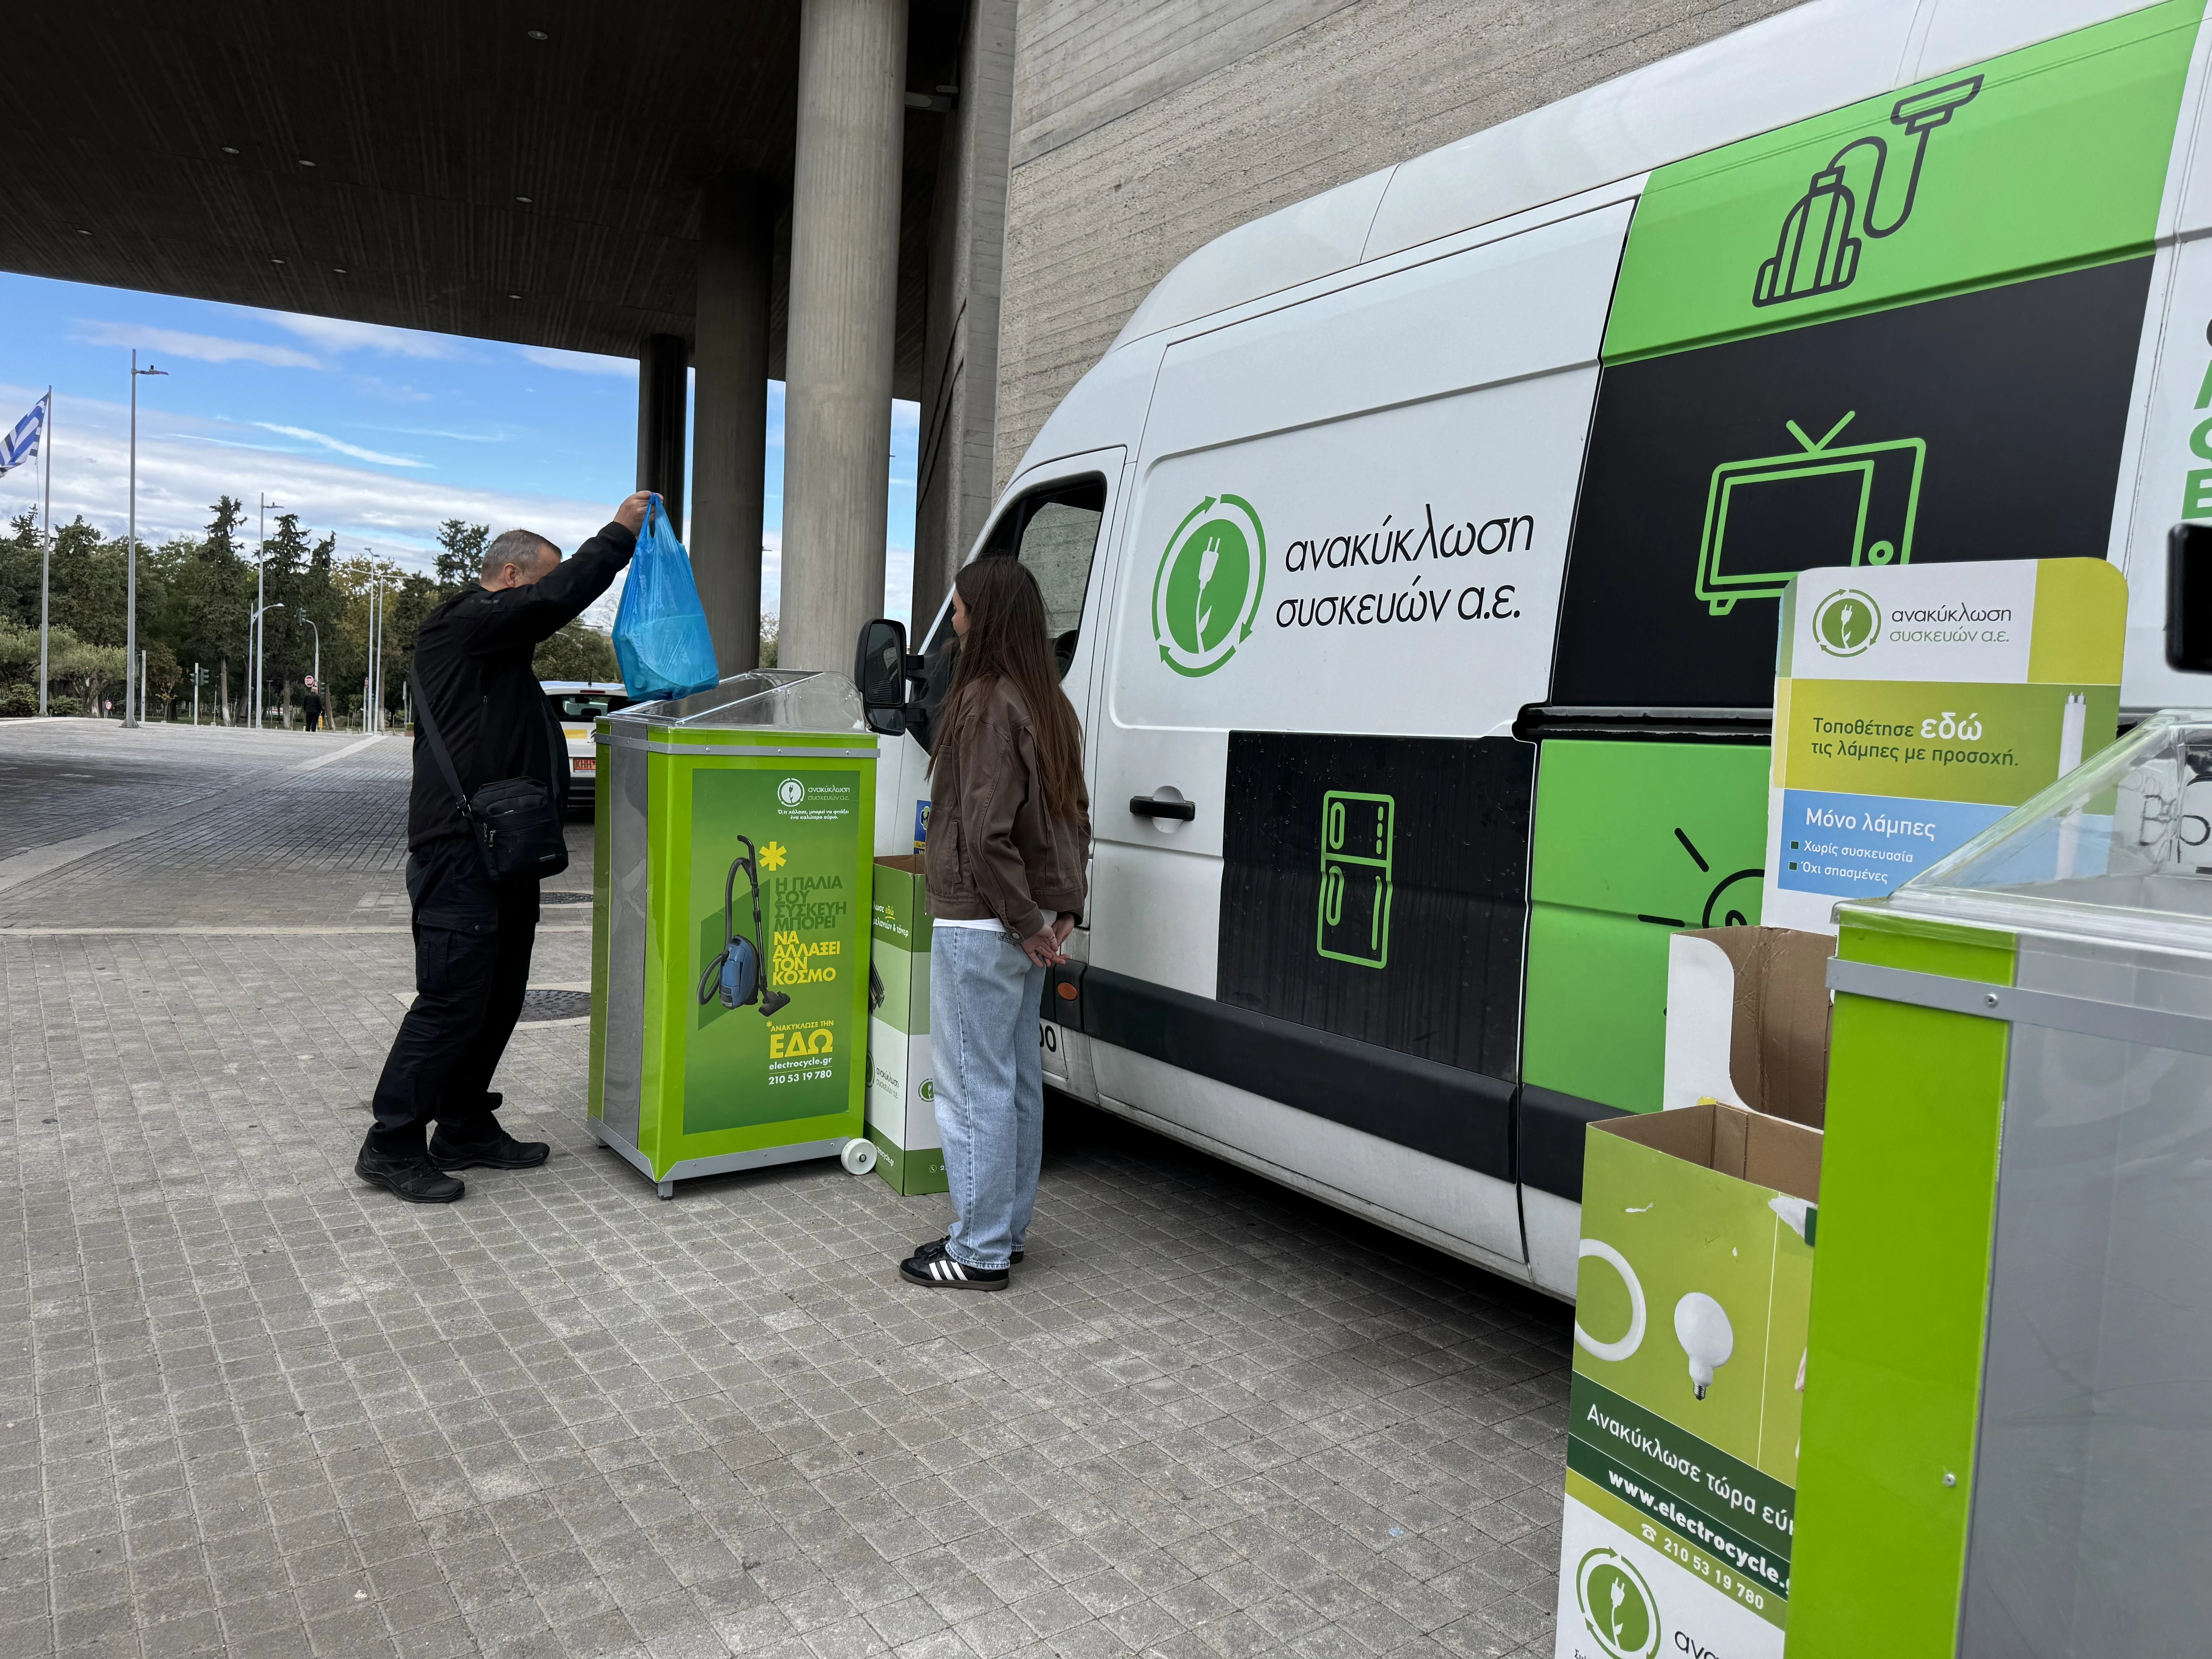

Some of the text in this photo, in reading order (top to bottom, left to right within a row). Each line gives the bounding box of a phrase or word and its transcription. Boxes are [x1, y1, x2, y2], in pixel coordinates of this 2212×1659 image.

[1286, 504, 1534, 572] ανακύκλωση
[1276, 576, 1520, 627] συσκευών α.ε.
[1891, 602, 2011, 623] ανακύκλωση
[1890, 626, 2009, 643] συσκευών α.ε.
[1813, 712, 1982, 741] Τοποθέτησε εδώ
[1812, 740, 2018, 767] τις λάμπες με προσοχή.
[808, 785, 850, 793] ανακύκλωση
[1806, 807, 1936, 841] Μόνο λάμπες
[1804, 840, 1913, 863] Χωρίς συσκευασία
[1801, 861, 1888, 884] Όχι σπασμένες
[776, 876, 842, 891] Η ΠΑΛΙΑ
[775, 890, 811, 905] ΣΟΥ
[775, 901, 847, 918] ΣΥΣΚΕΥΗ
[885, 905, 894, 915] εδώ
[774, 915, 836, 932] ΜΠΟΡΕΙ
[774, 931, 799, 945] ΝΑ
[773, 941, 840, 959] ΑΛΛΑΞΕΙ
[773, 957, 807, 972] ΤΟΝ
[773, 967, 836, 986] ΚΟΣΜΟ
[771, 1022, 819, 1032] ΑΝΑΚΥΚΛΩΣΕ
[770, 1029, 833, 1059] ΕΔΩ
[769, 1057, 832, 1070] electrocycle.gr
[769, 1070, 832, 1085] 210 53 19 780
[1587, 1404, 1701, 1483] Ανακύκλωσε
[1706, 1473, 1756, 1515] τώρα
[1664, 1537, 1764, 1610] 210 53 19 780
